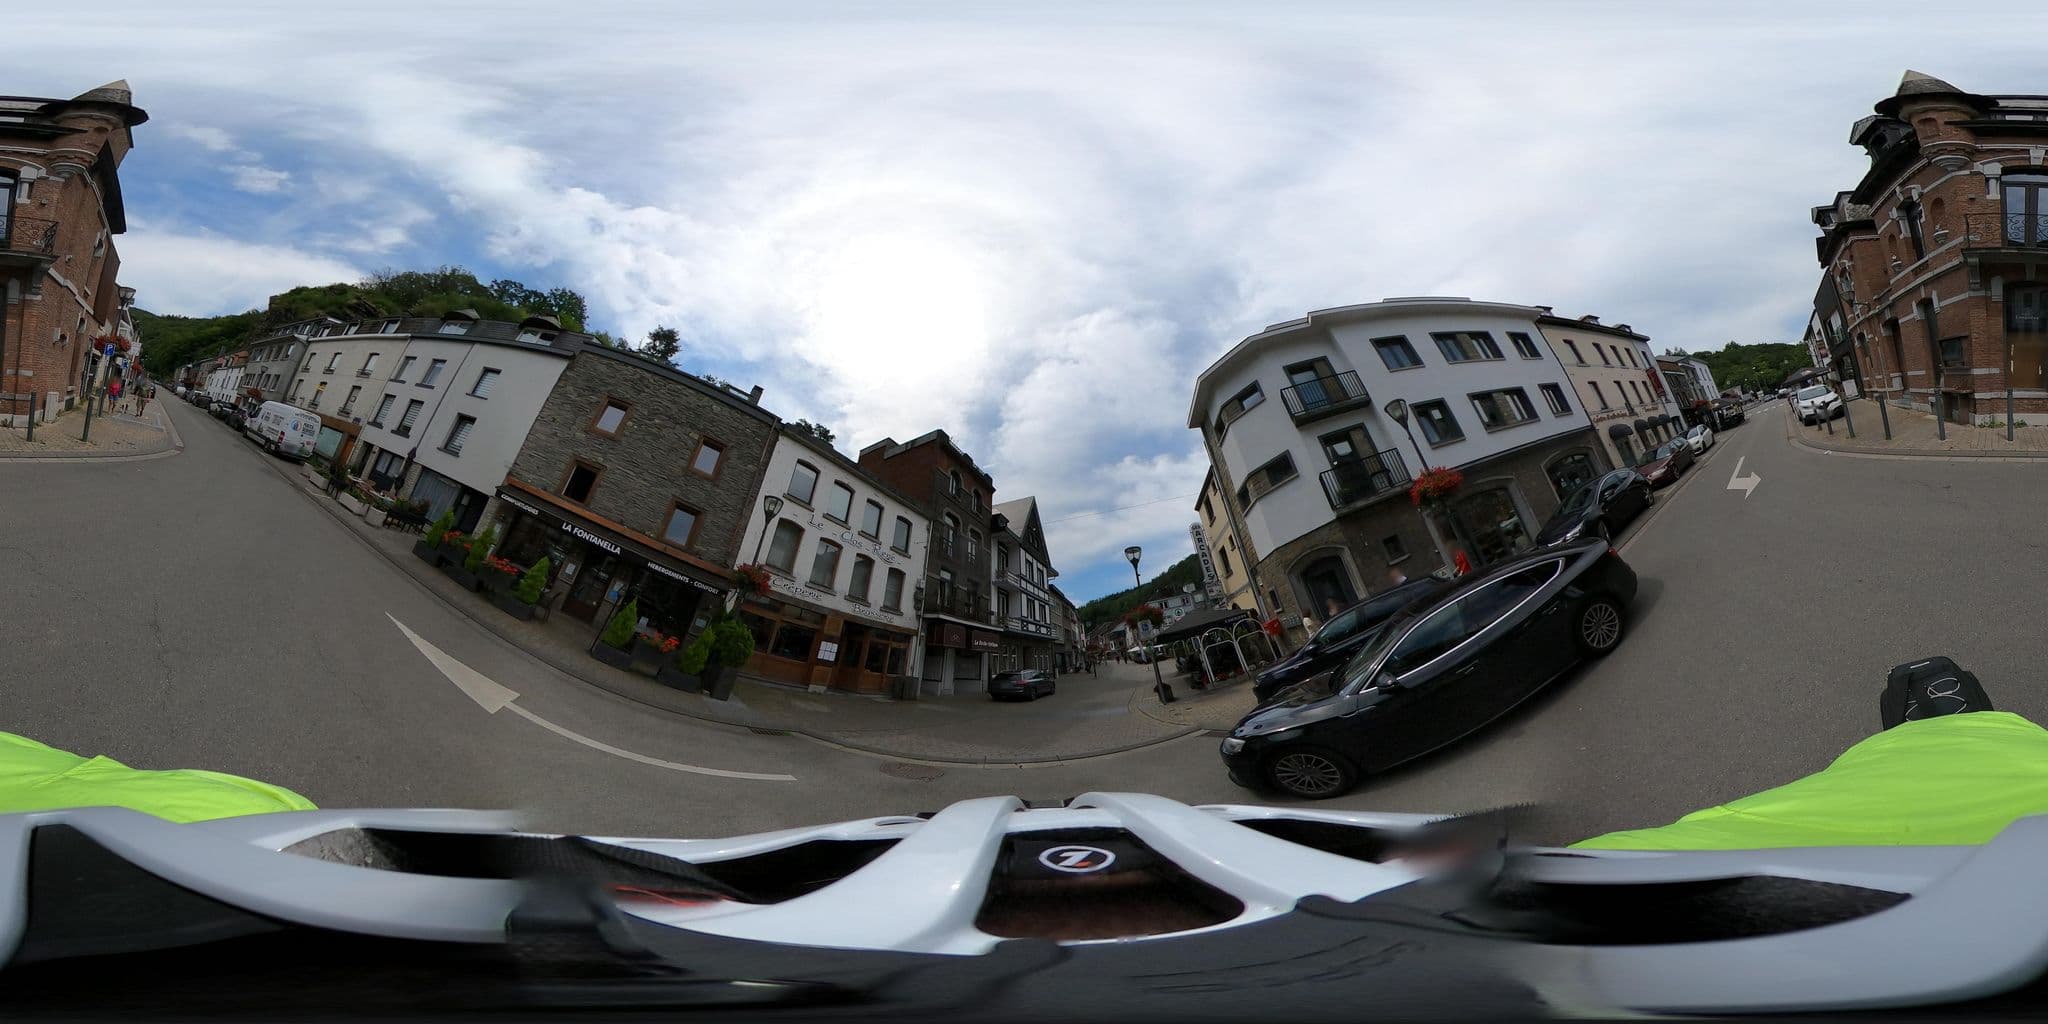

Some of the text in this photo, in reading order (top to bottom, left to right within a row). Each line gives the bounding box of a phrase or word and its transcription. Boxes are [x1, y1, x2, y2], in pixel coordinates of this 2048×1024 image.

[562, 522, 621, 555] LA FONTANELLA
[807, 514, 824, 530] Le
[840, 530, 863, 550] Clos
[1195, 530, 1216, 581] ARCADES
[694, 580, 719, 595] CONFORT
[772, 577, 822, 601] Crêperie
